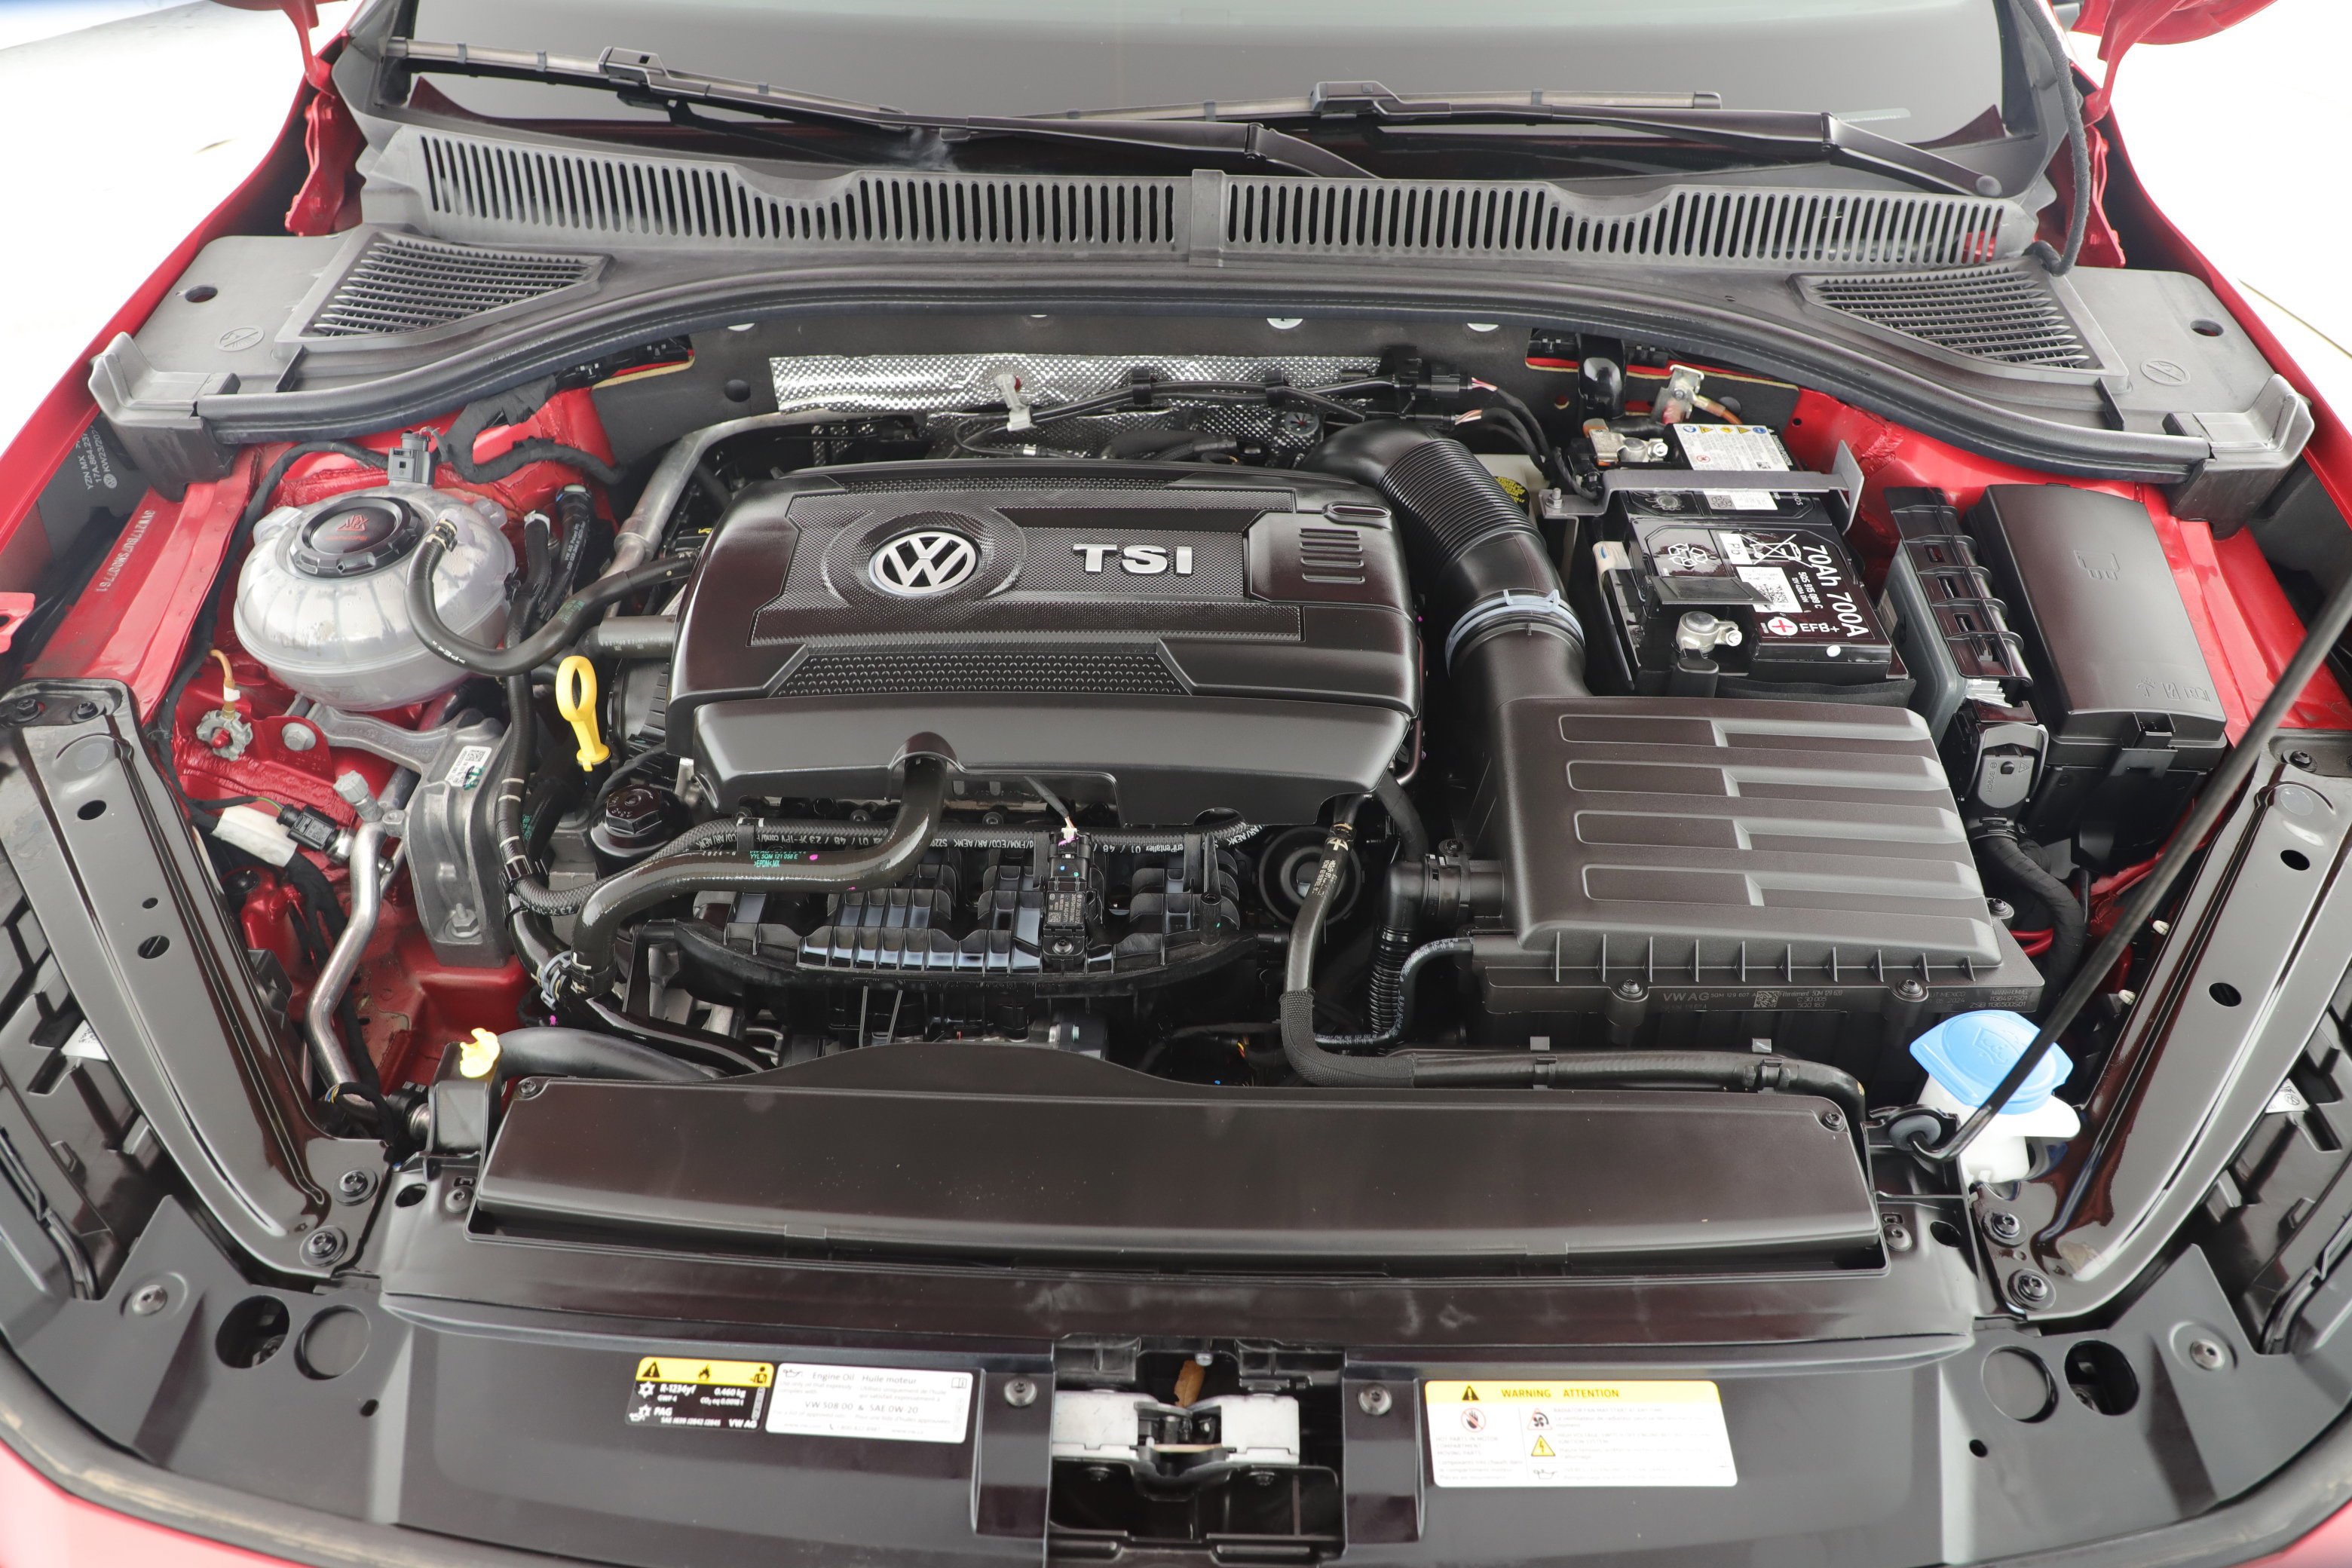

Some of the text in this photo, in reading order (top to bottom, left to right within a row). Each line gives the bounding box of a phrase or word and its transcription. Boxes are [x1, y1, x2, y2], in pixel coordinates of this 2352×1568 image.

[1727, 542, 1741, 556] Pb
[1072, 543, 1196, 577] TSI
[1802, 544, 1870, 638] 70Ah 700A
[1799, 622, 1840, 633] EFB+
[1663, 992, 1686, 1002] VW
[1687, 992, 1710, 1001] AG
[812, 1371, 917, 1385] Engine Oil Huile moteur
[659, 1383, 697, 1396] R-1234yf
[736, 1389, 747, 1398] kg
[1501, 1389, 1620, 1398] WARNING ATTENTION
[654, 1406, 673, 1416] PAG
[804, 1401, 820, 1409] VW
[822, 1401, 839, 1410] 508
[841, 1402, 853, 1410] 00
[869, 1404, 886, 1412] SAE
[728, 1418, 744, 1428] VW
[743, 1419, 758, 1429] AG
